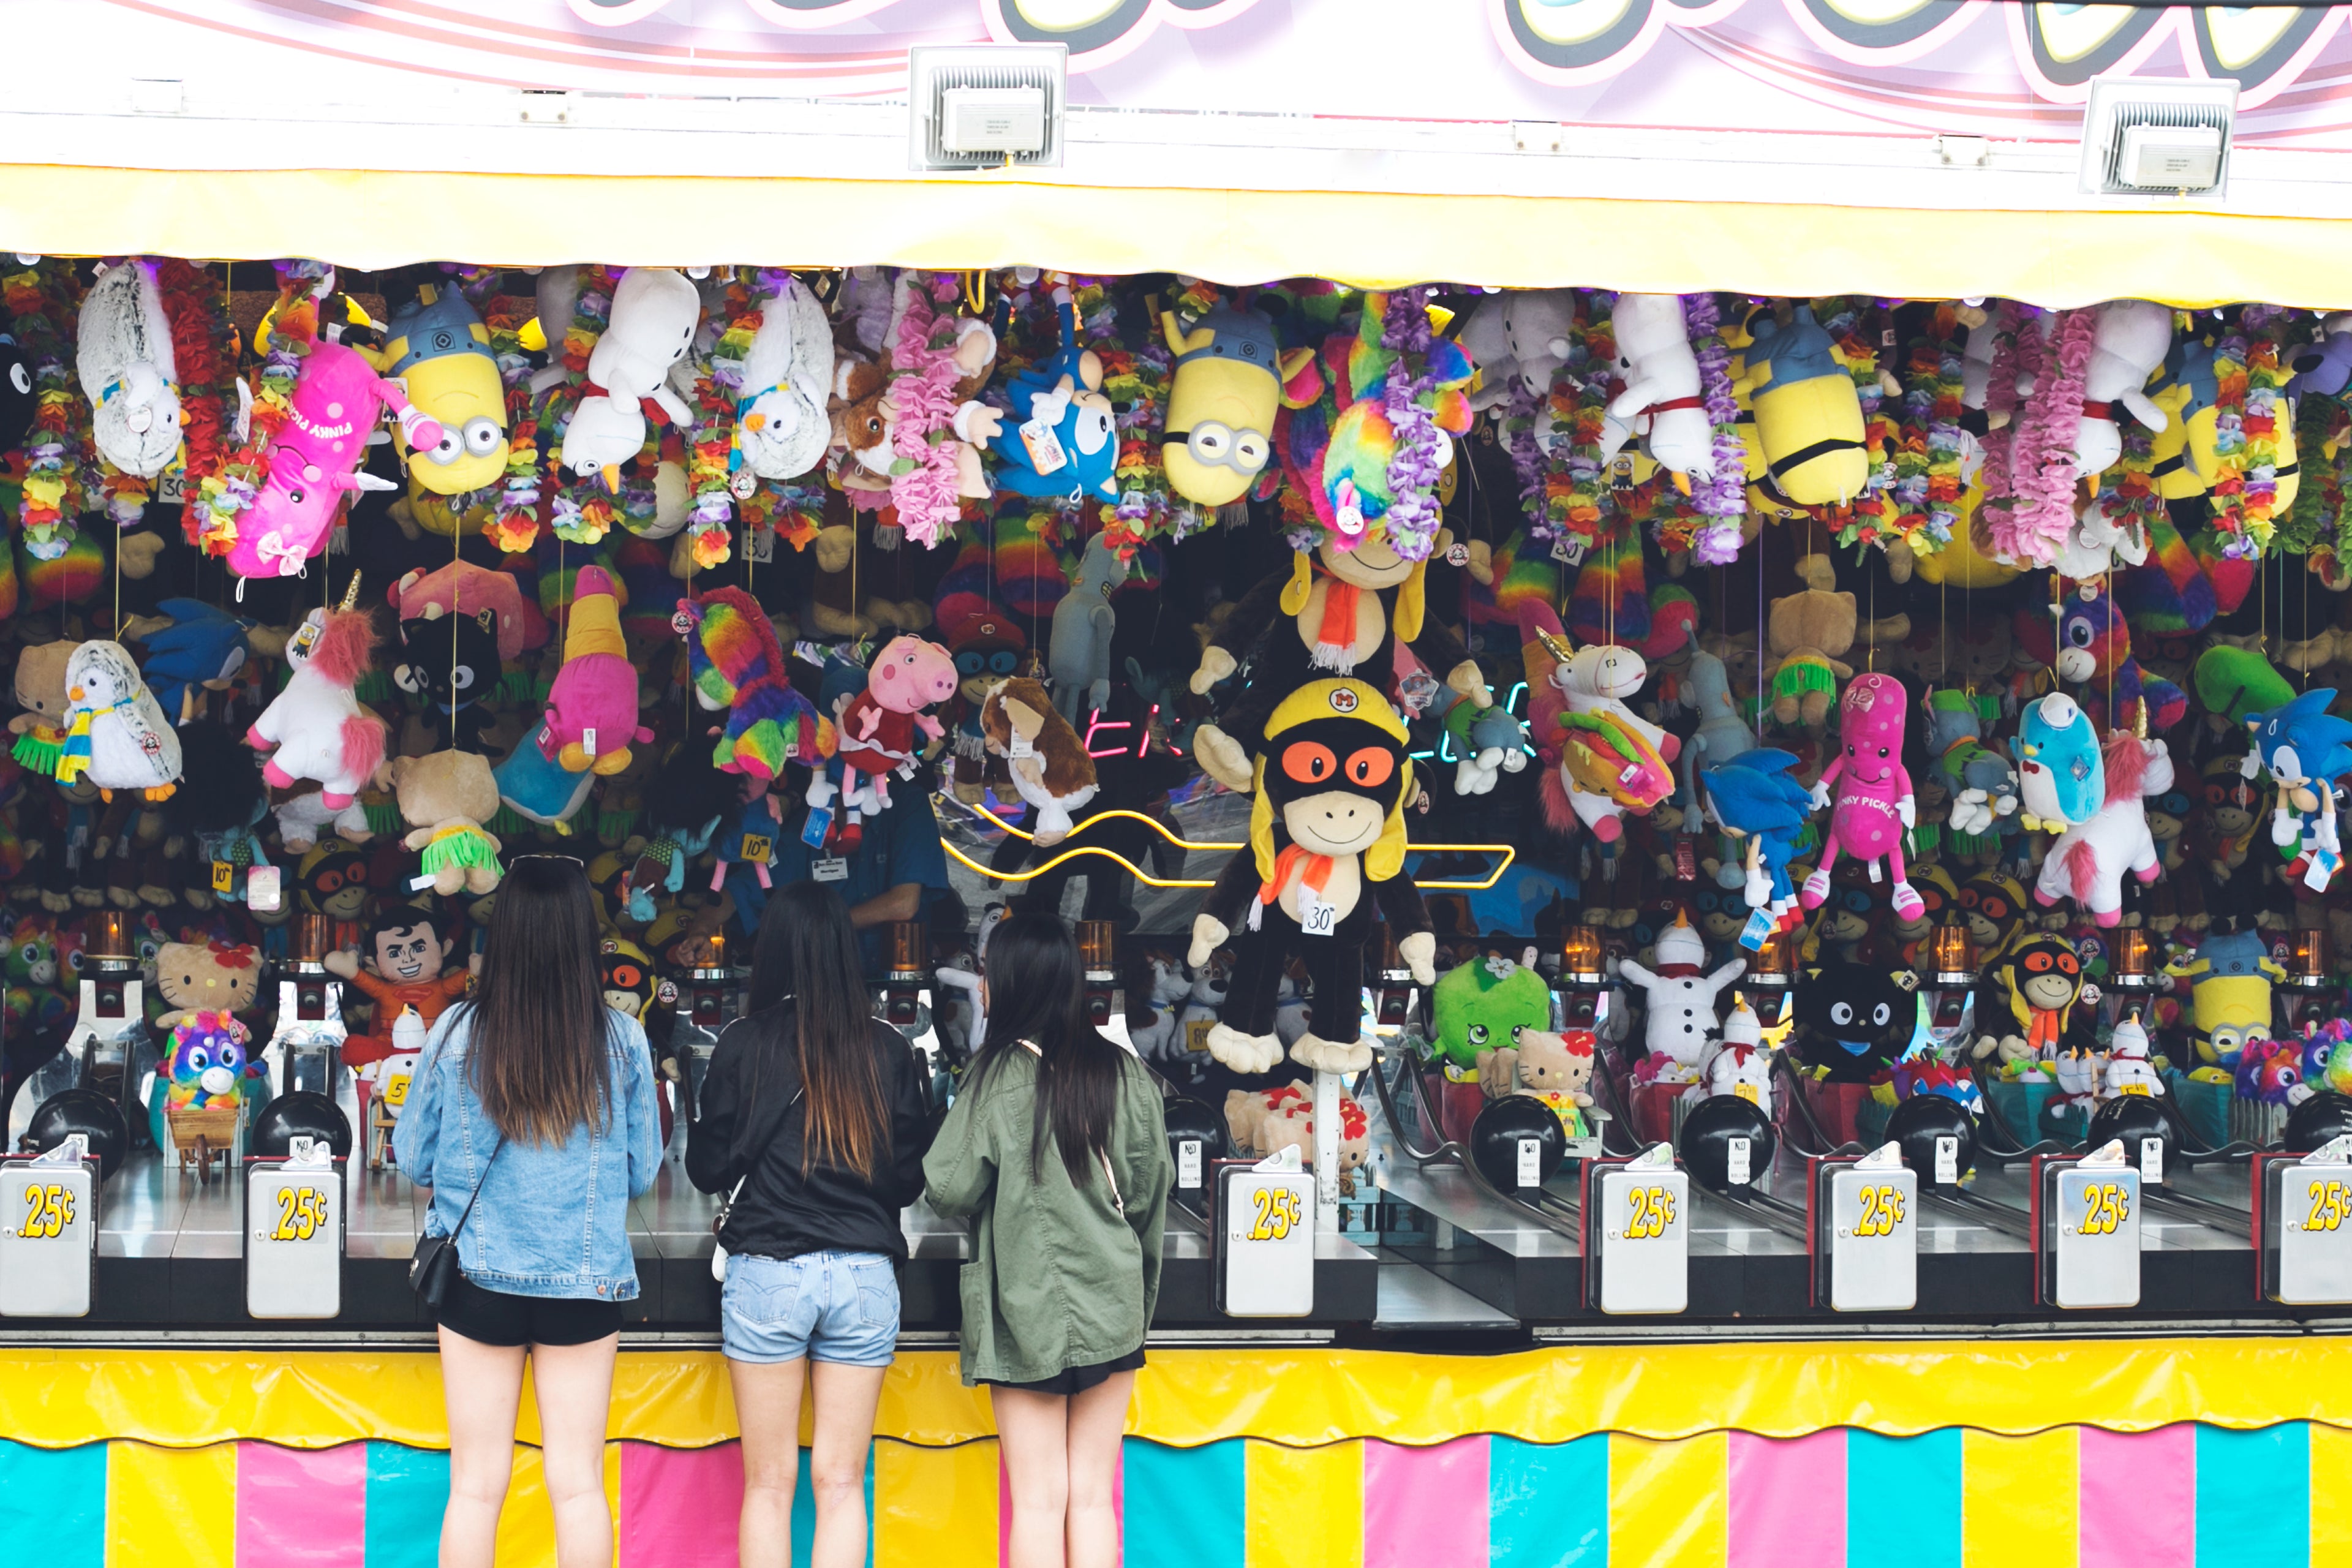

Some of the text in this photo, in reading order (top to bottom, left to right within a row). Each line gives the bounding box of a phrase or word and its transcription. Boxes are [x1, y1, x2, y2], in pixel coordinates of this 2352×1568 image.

[309, 422, 353, 439] PINKY
[1336, 693, 1354, 707] M
[1862, 796, 1895, 819] PICKLE
[296, 1140, 308, 1150] NO
[1185, 1144, 1196, 1154] NO
[1525, 1143, 1536, 1153] NO
[1735, 1141, 1746, 1151] NO
[1942, 1140, 1953, 1150] NO
[2147, 1141, 2158, 1150] NO
[17, 1184, 75, 1238] .25¢
[270, 1187, 328, 1241] .25¢
[1246, 1188, 1301, 1241] .25¢
[1623, 1187, 1676, 1240] .25¢
[1852, 1185, 1906, 1237] .25¢
[2077, 1184, 2129, 1235] .25¢
[2301, 1180, 2352, 1231] .25¢
